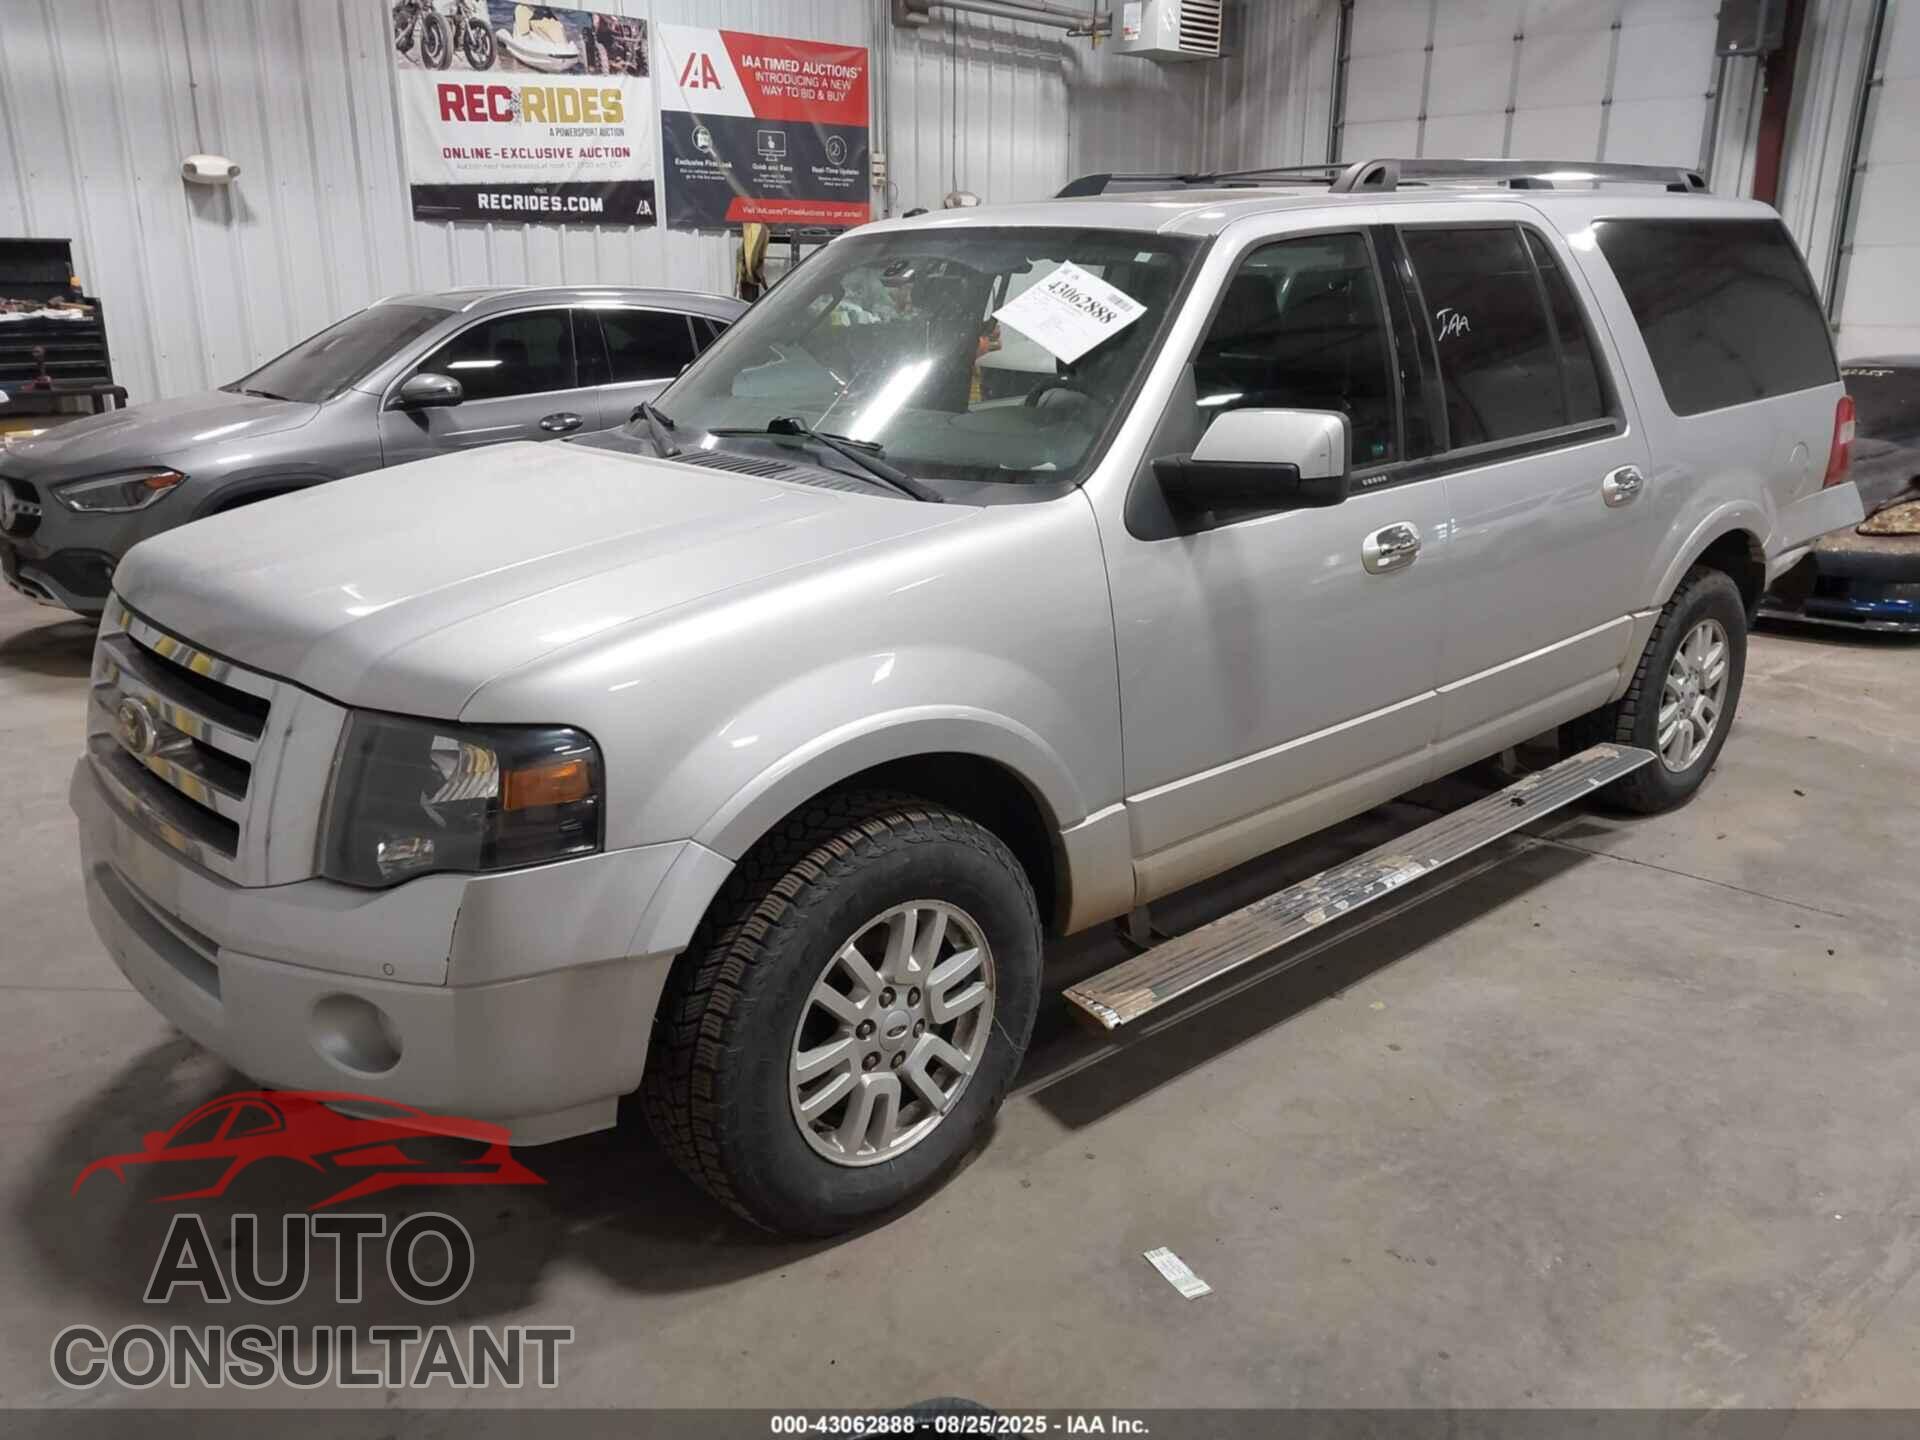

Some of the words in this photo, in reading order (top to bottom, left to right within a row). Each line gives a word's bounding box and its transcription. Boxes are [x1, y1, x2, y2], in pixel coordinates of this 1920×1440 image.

[741, 54, 762, 68] IAA
[763, 57, 800, 73] TIMED
[755, 71, 819, 88] INTRODUCING
[821, 78, 830, 89] A
[831, 79, 851, 91] NEW
[760, 84, 783, 97] WAY
[786, 86, 799, 98] TO
[800, 87, 816, 100] BID
[817, 89, 826, 100] &
[827, 89, 847, 102] BUY
[437, 83, 514, 122] REC
[520, 86, 625, 124] RIDES
[442, 147, 574, 160] ONLINE-EXCLUSIVE
[578, 146, 631, 159] AUCTION
[477, 193, 604, 212] RECRIDES.COM
[1047, 280, 1118, 325] 43062888
